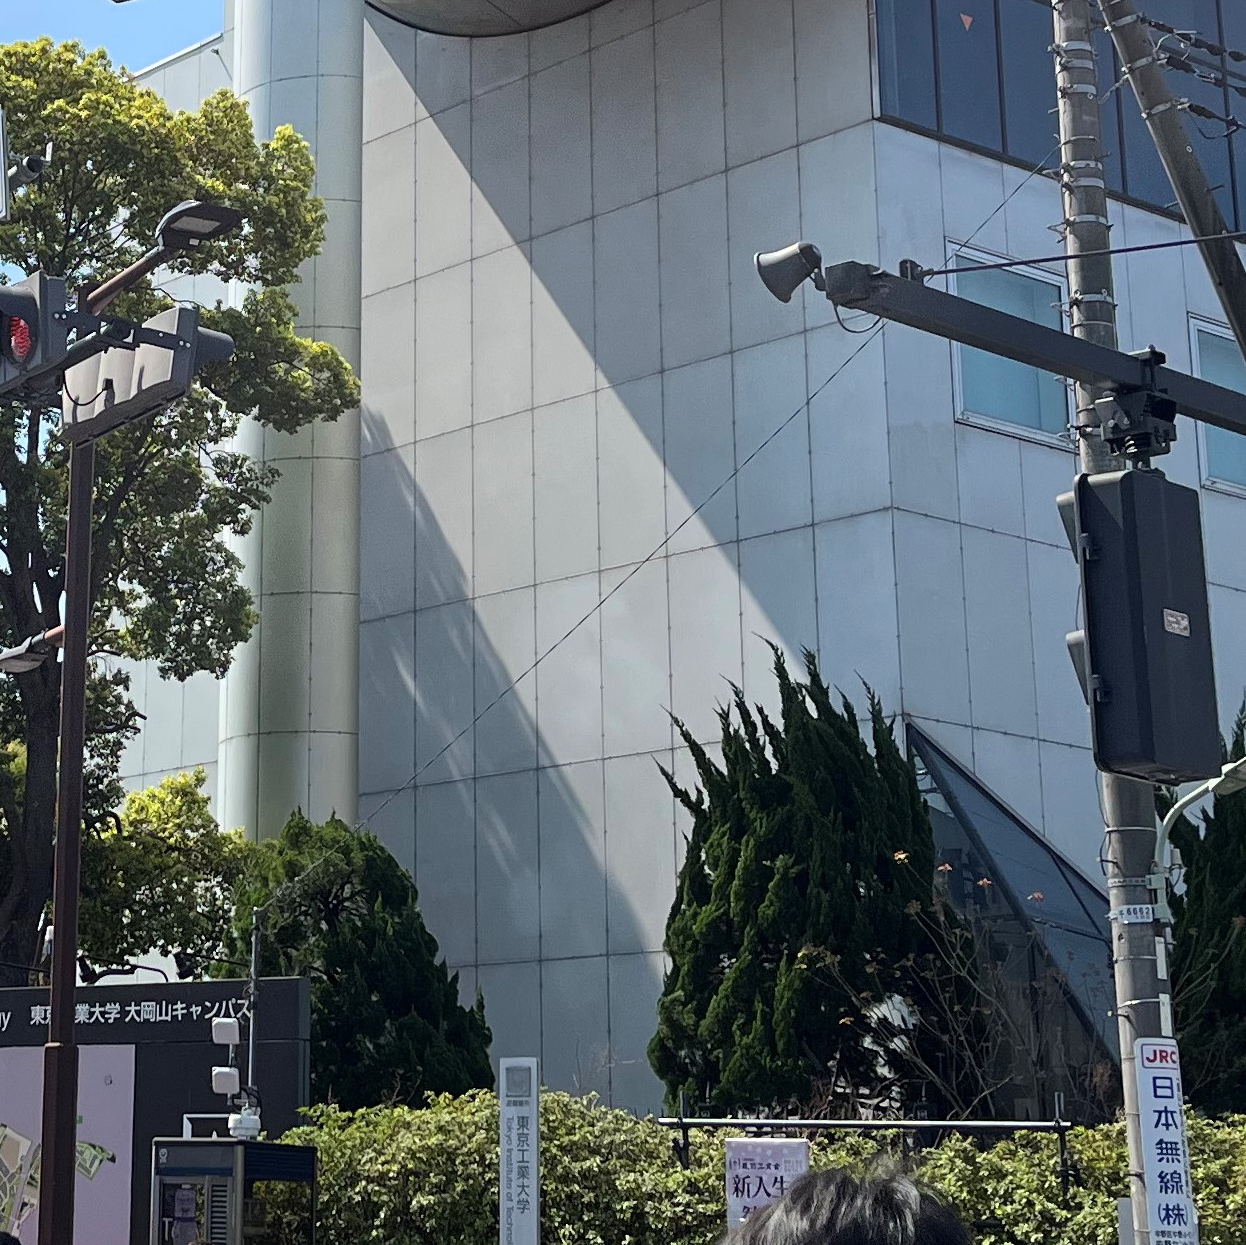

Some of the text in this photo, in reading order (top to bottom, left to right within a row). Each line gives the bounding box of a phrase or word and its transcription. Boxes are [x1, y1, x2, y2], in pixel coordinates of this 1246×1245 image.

[124, 997, 251, 1023] 大岡山キャンパス
[1145, 1049, 1178, 1064] JRC
[505, 1115, 515, 1146] Tokyo
[516, 1115, 531, 1215] 東京工業大学
[1152, 1076, 1189, 1227] 日本無線(株)
